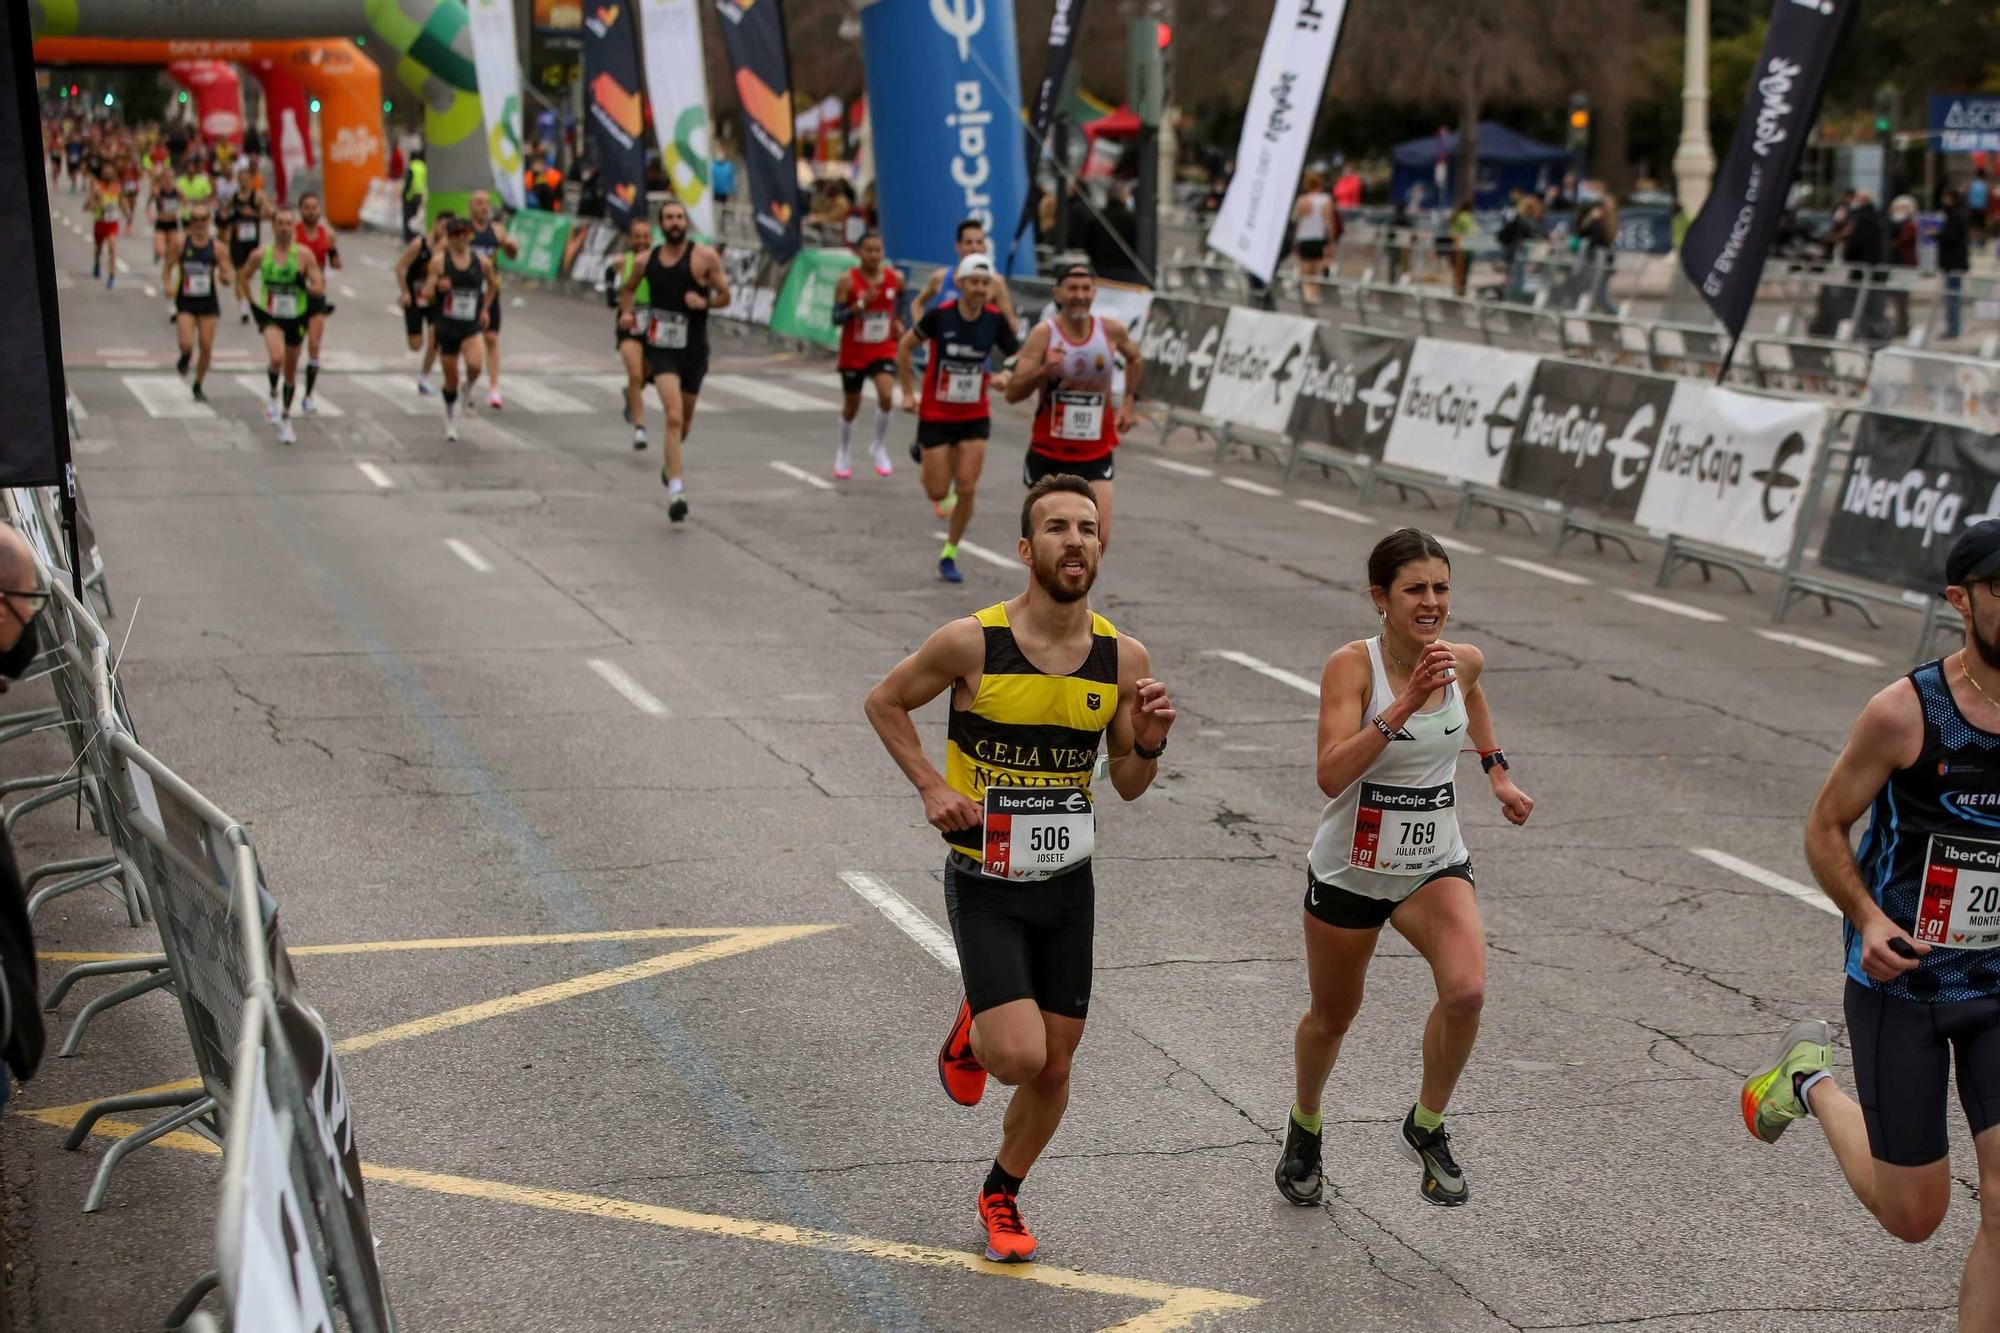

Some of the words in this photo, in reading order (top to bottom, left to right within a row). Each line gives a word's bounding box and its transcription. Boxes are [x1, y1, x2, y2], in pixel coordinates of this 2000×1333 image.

[1402, 376, 1479, 438] iberCaja
[1523, 394, 1608, 468] iberCaja
[1658, 424, 1744, 500] iberCaja
[1843, 456, 1963, 548] iberCaja
[999, 796, 1055, 809] iberCaja
[1371, 791, 1426, 807] iberCaja
[1030, 826, 1070, 852] 506
[1400, 821, 1436, 846] 769
[1036, 853, 1065, 863] JOSETE
[1359, 849, 1373, 862] 01
[1395, 845, 1416, 857] JÚLIA
[1418, 845, 1436, 856] FONT
[992, 861, 1006, 873] 01
[1967, 885, 2000, 912] 20
[1927, 919, 1944, 935] 01
